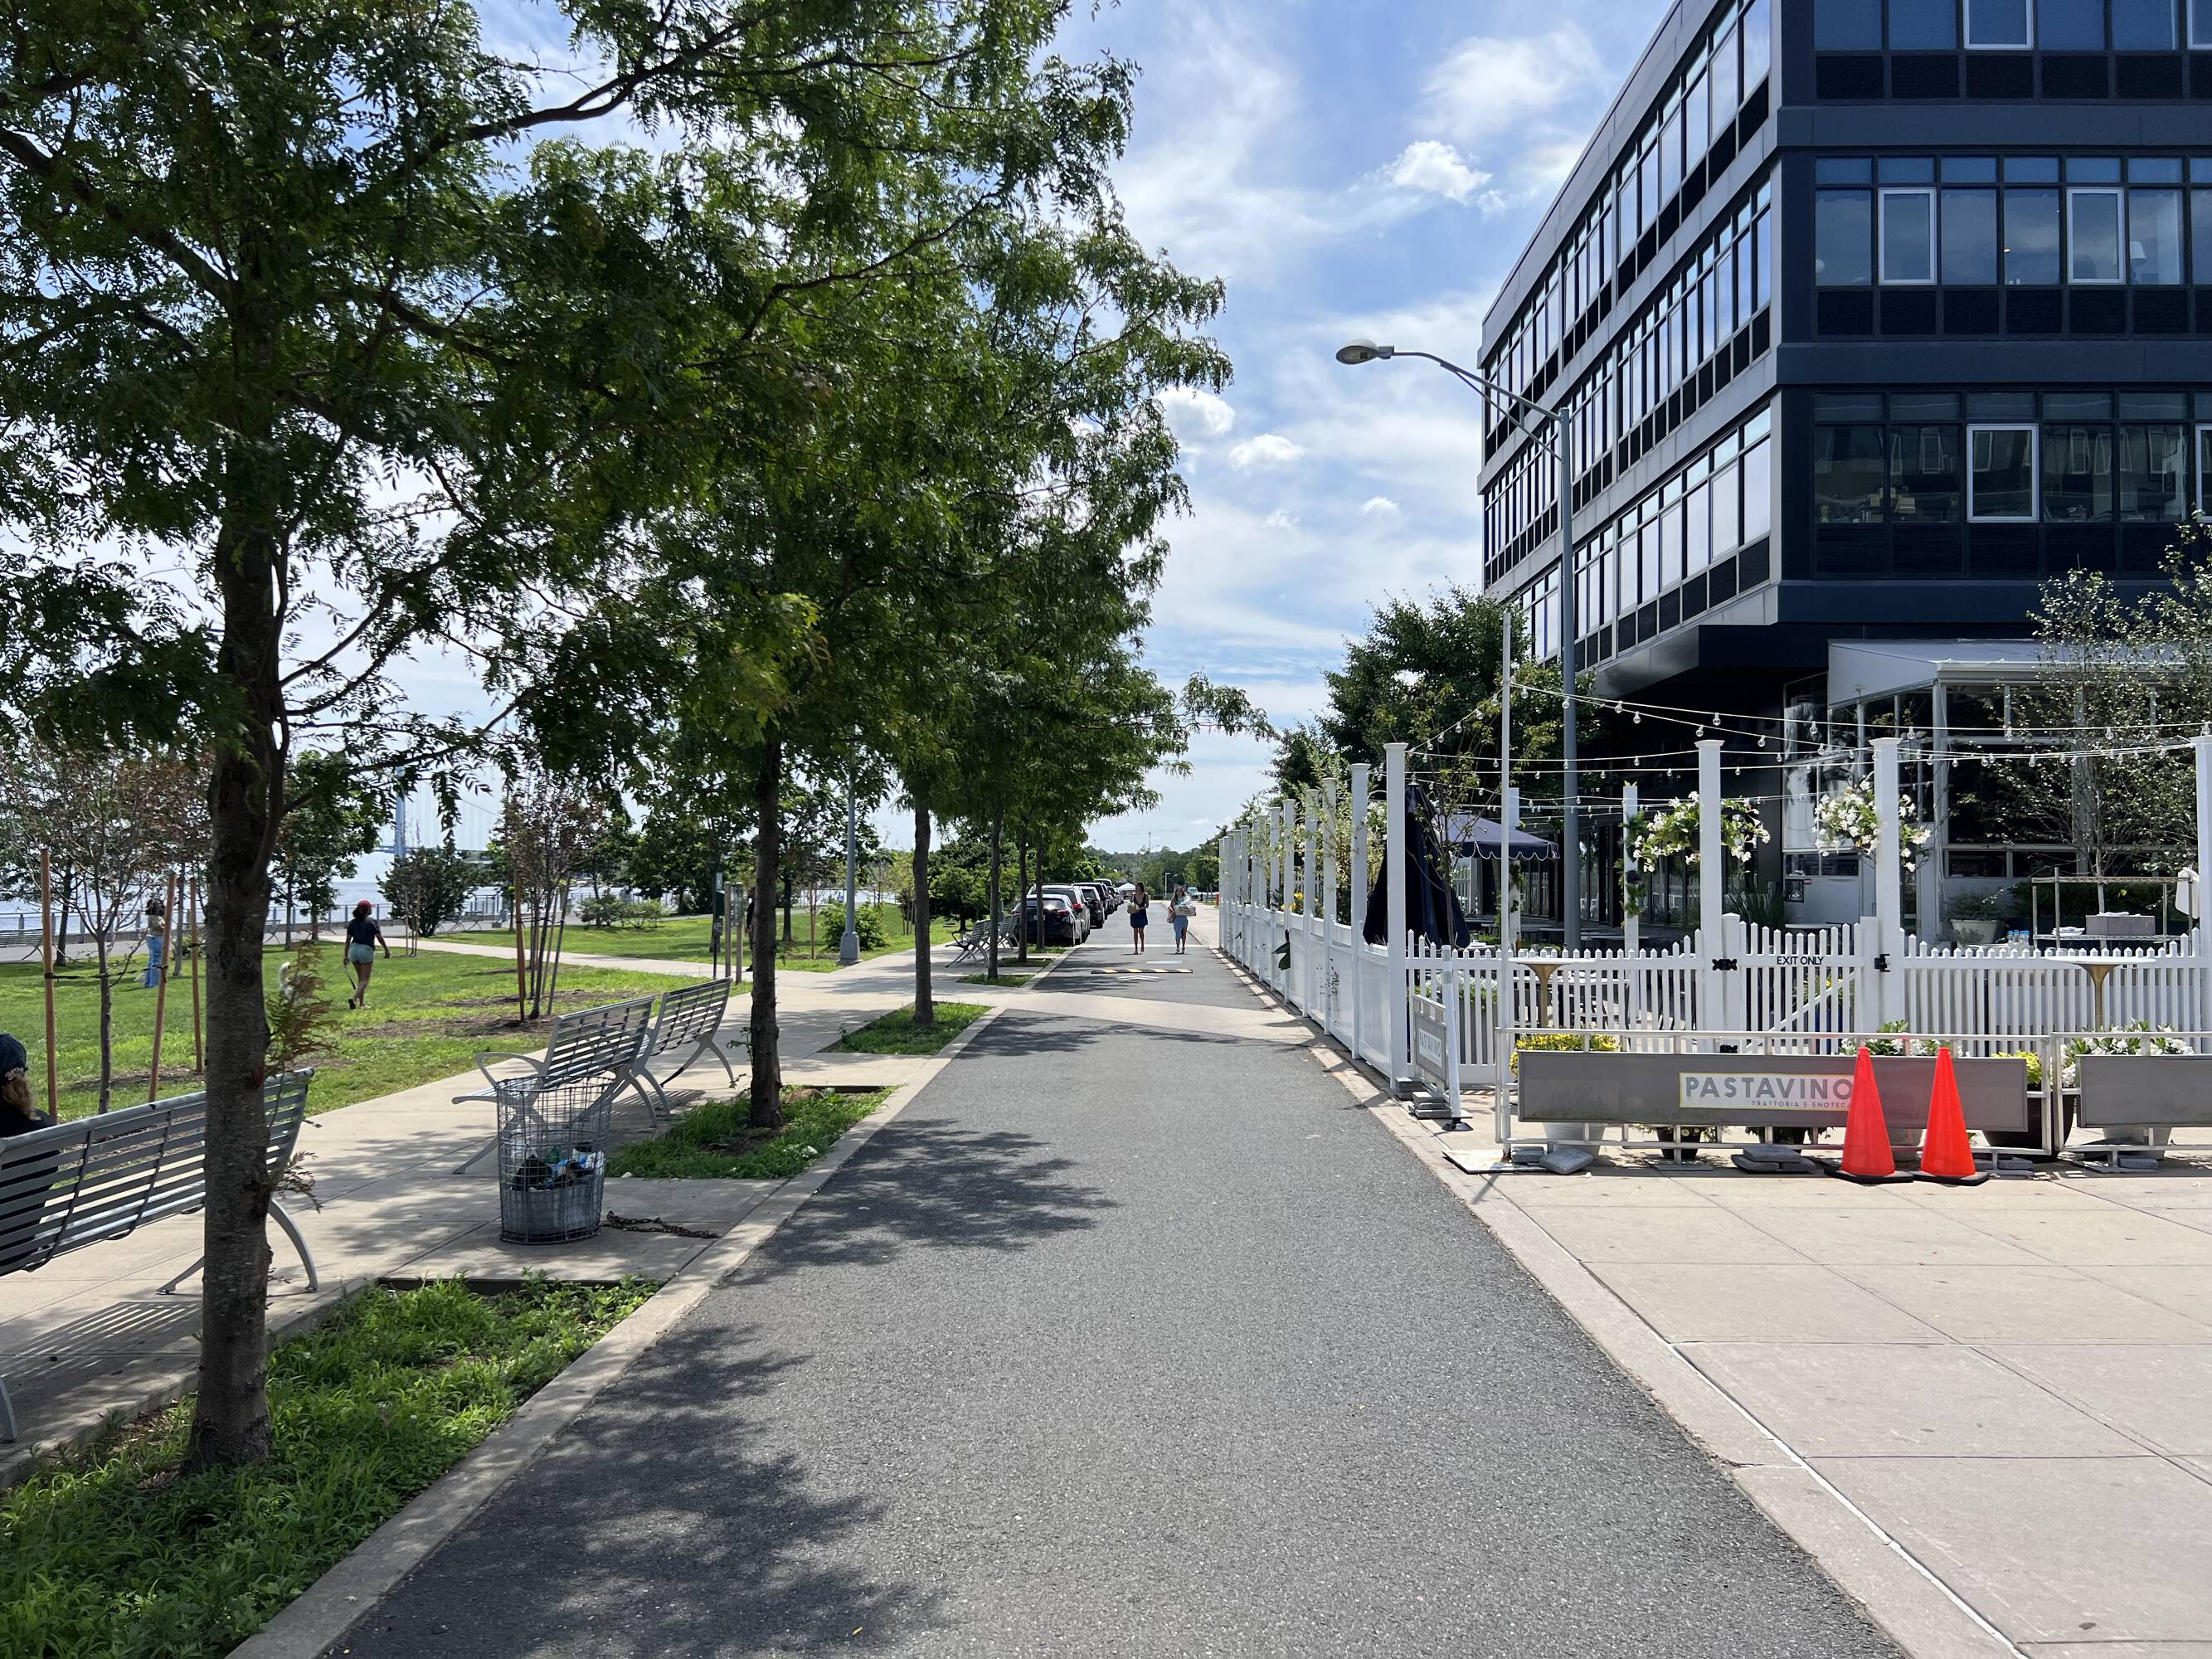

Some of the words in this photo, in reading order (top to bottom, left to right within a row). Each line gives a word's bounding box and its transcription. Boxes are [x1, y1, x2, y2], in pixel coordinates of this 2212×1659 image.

[1777, 956, 1798, 965] EXIT
[1800, 956, 1824, 965] ONLY
[1685, 1077, 1852, 1099] PASTAVINO
